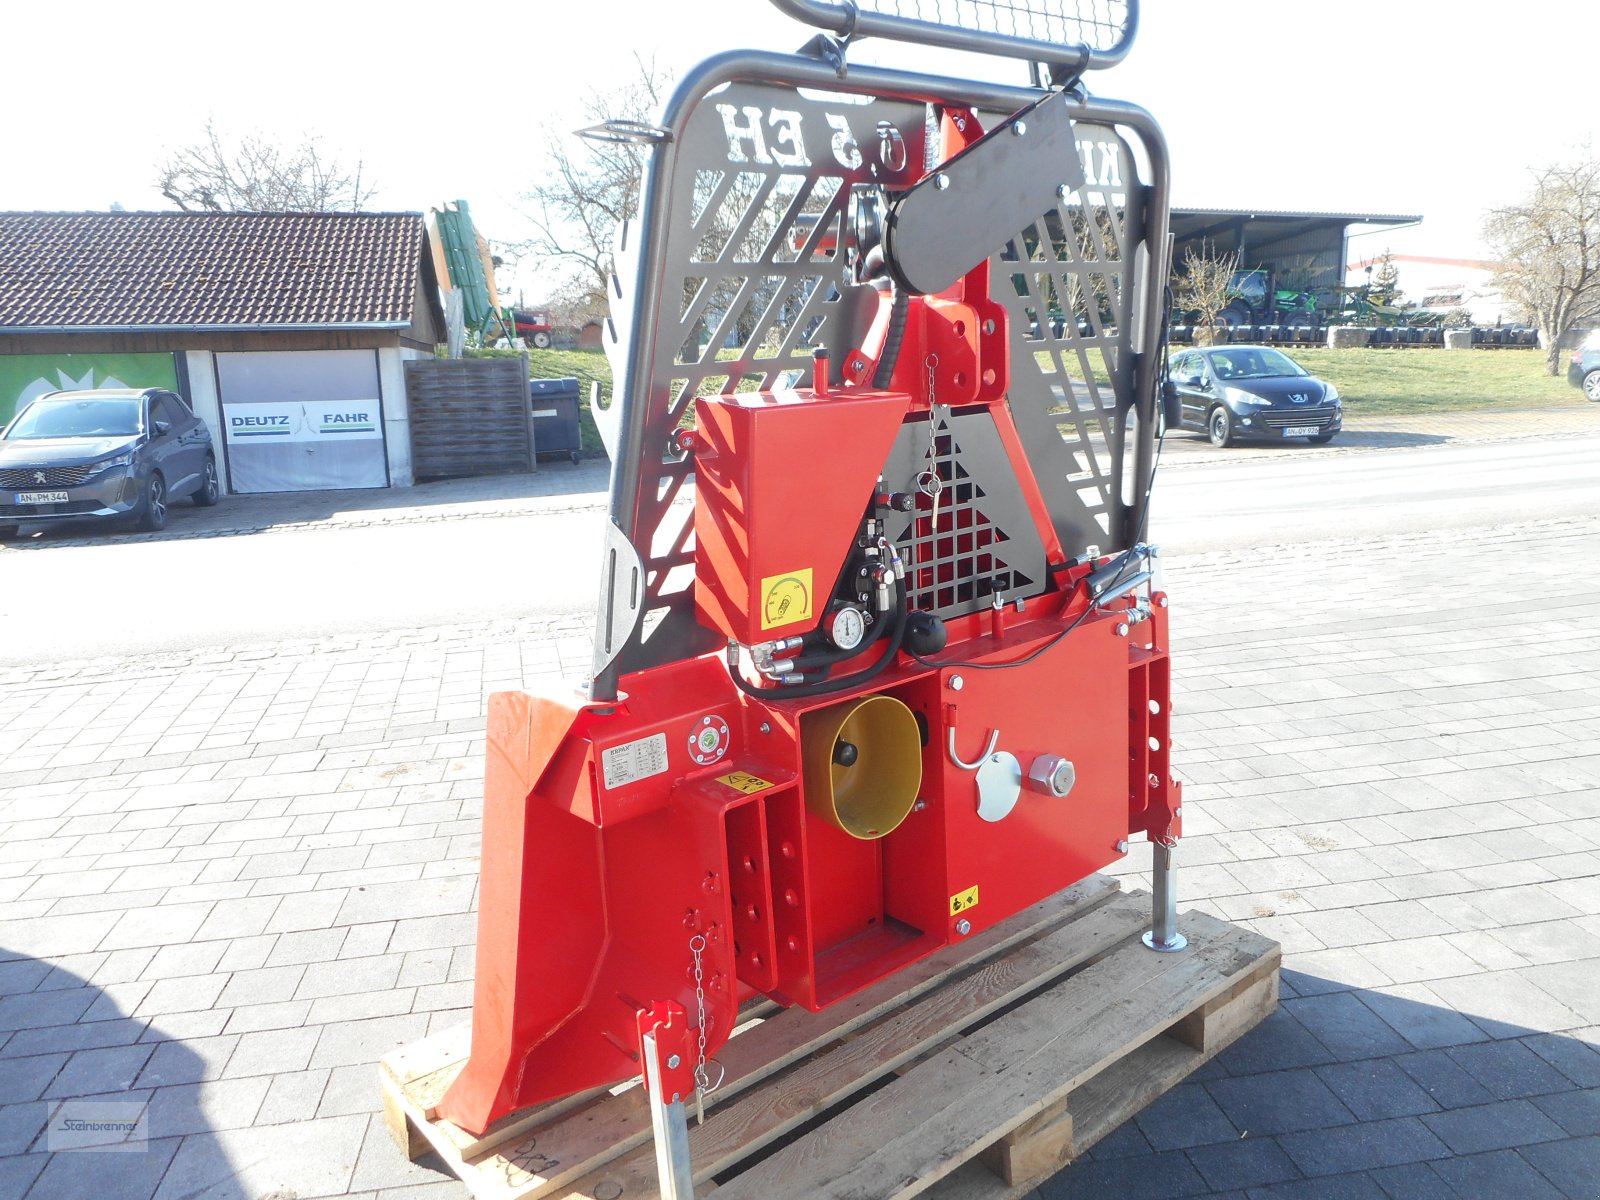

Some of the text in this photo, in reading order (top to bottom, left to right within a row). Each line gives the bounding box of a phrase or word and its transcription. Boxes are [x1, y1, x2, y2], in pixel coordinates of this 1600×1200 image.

[231, 413, 369, 427] DEUTZ FAHR
[20, 492, 68, 503] AN PM 344
